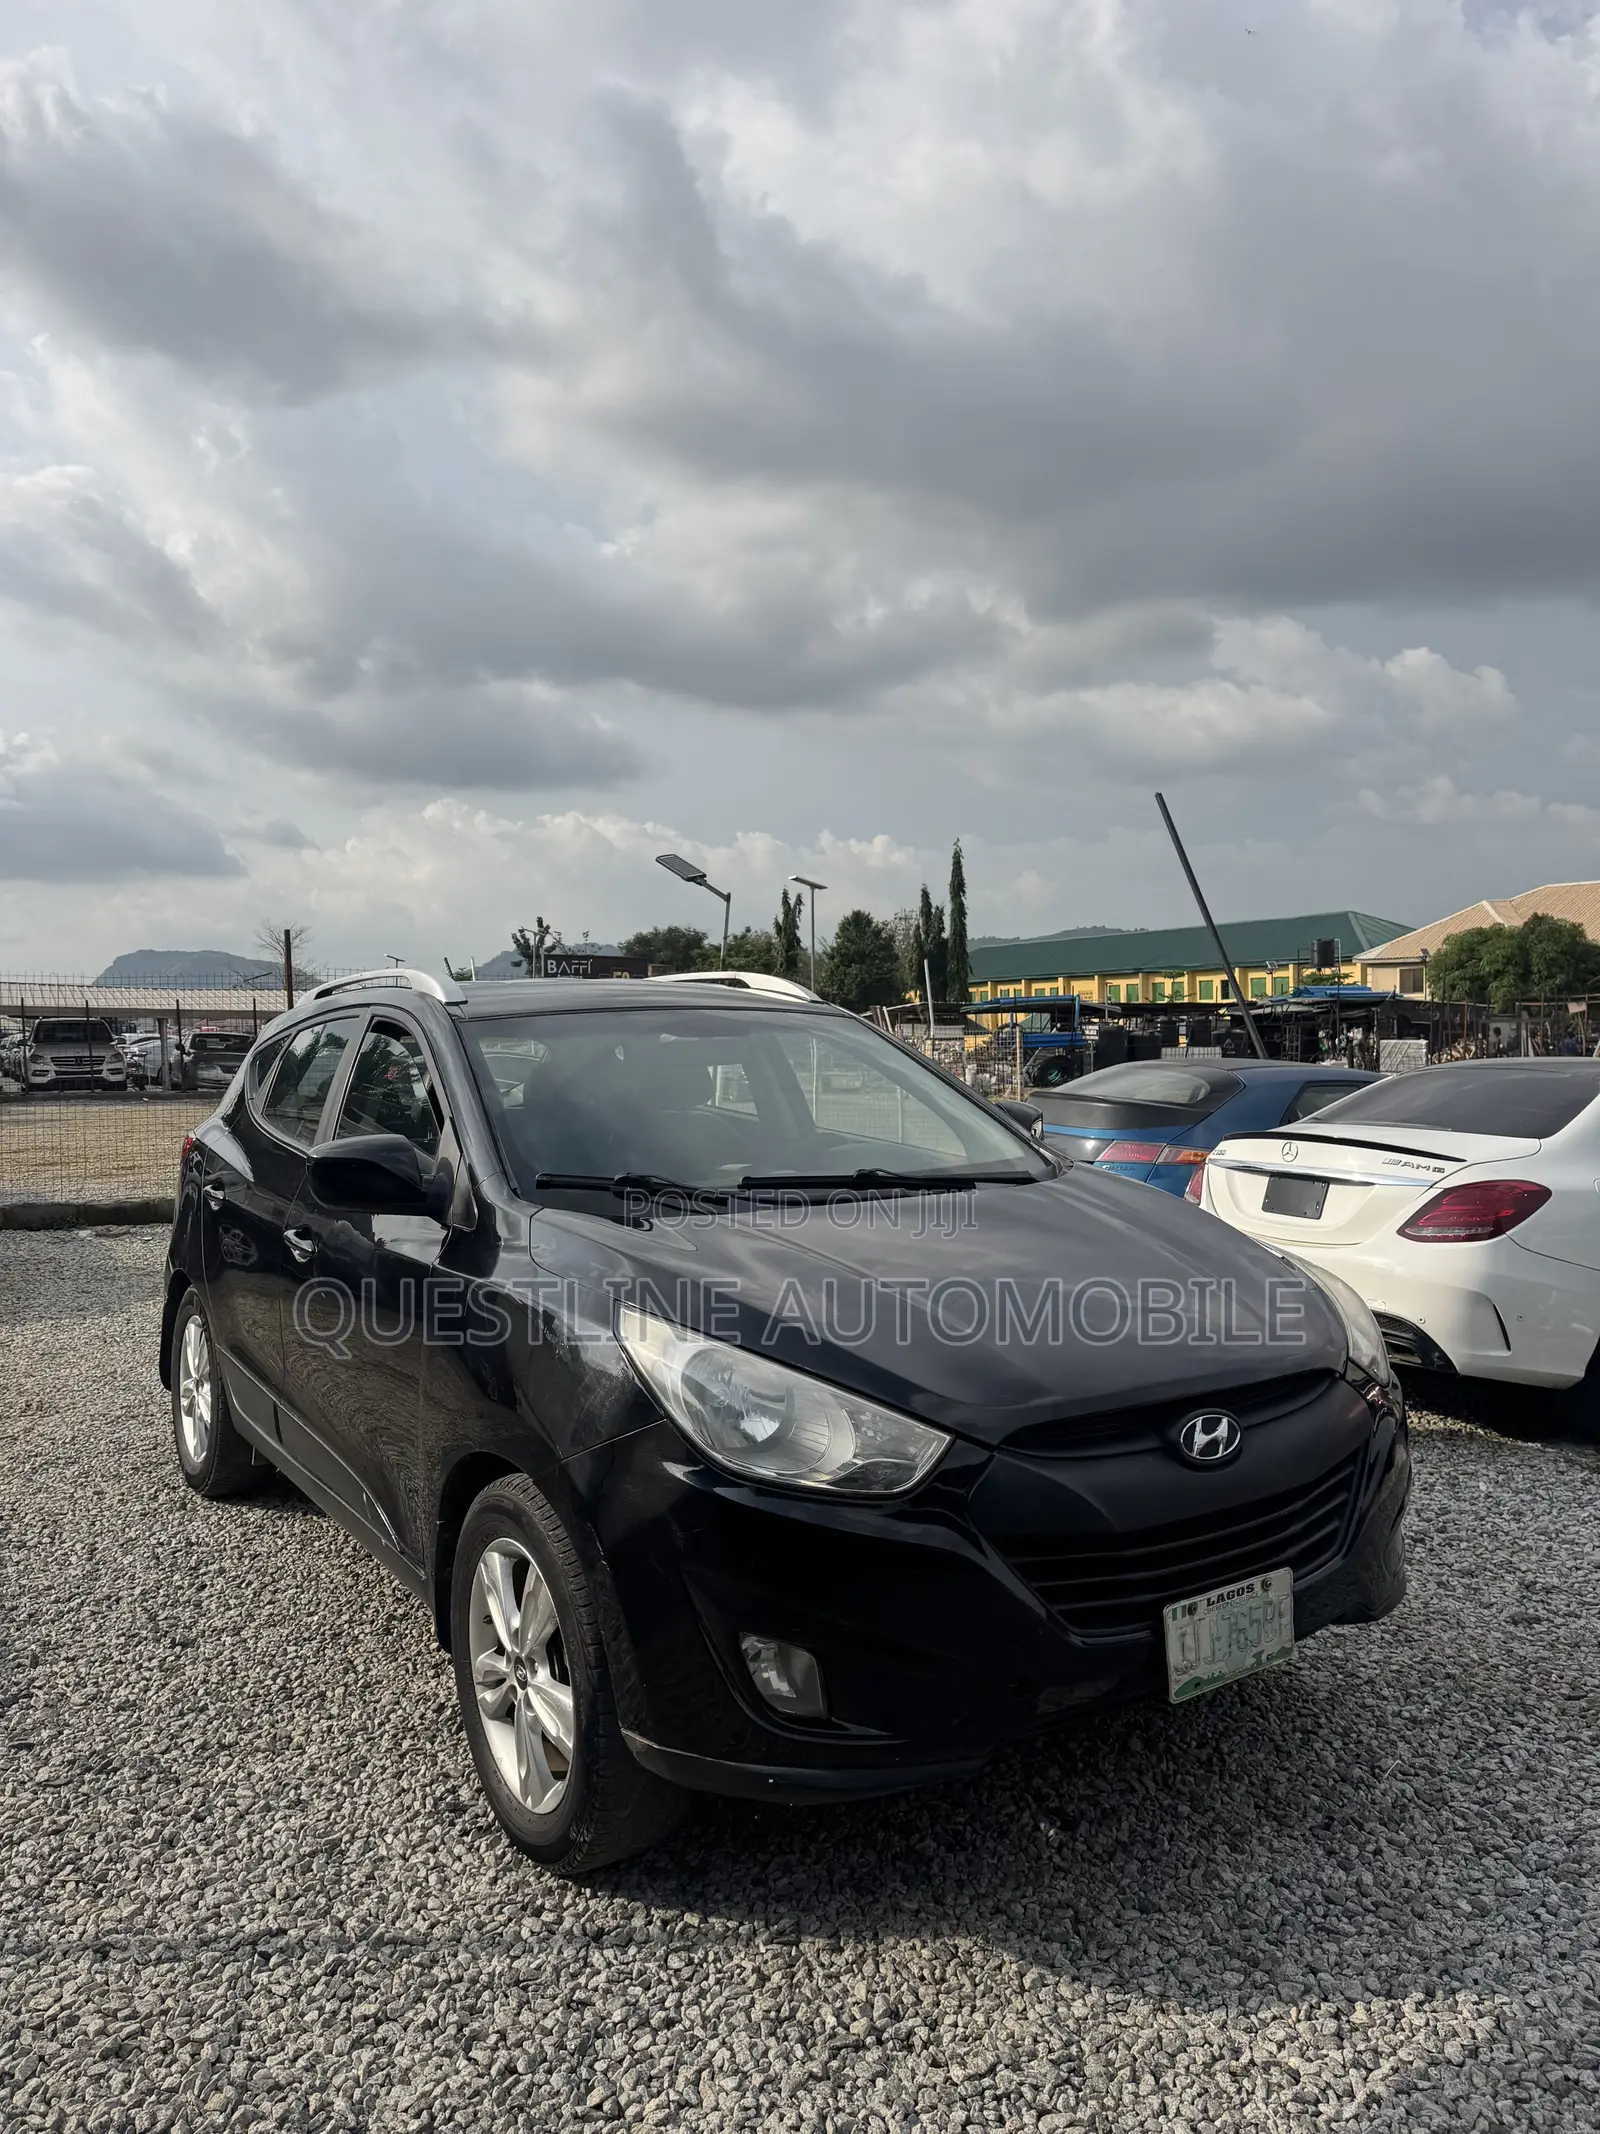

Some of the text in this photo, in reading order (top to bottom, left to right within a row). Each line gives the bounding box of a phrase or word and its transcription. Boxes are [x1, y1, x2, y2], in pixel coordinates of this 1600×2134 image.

[547, 958, 593, 974] BAFFI
[1400, 1161, 1446, 1174] AMG
[1206, 1583, 1255, 1607] LAGOS
